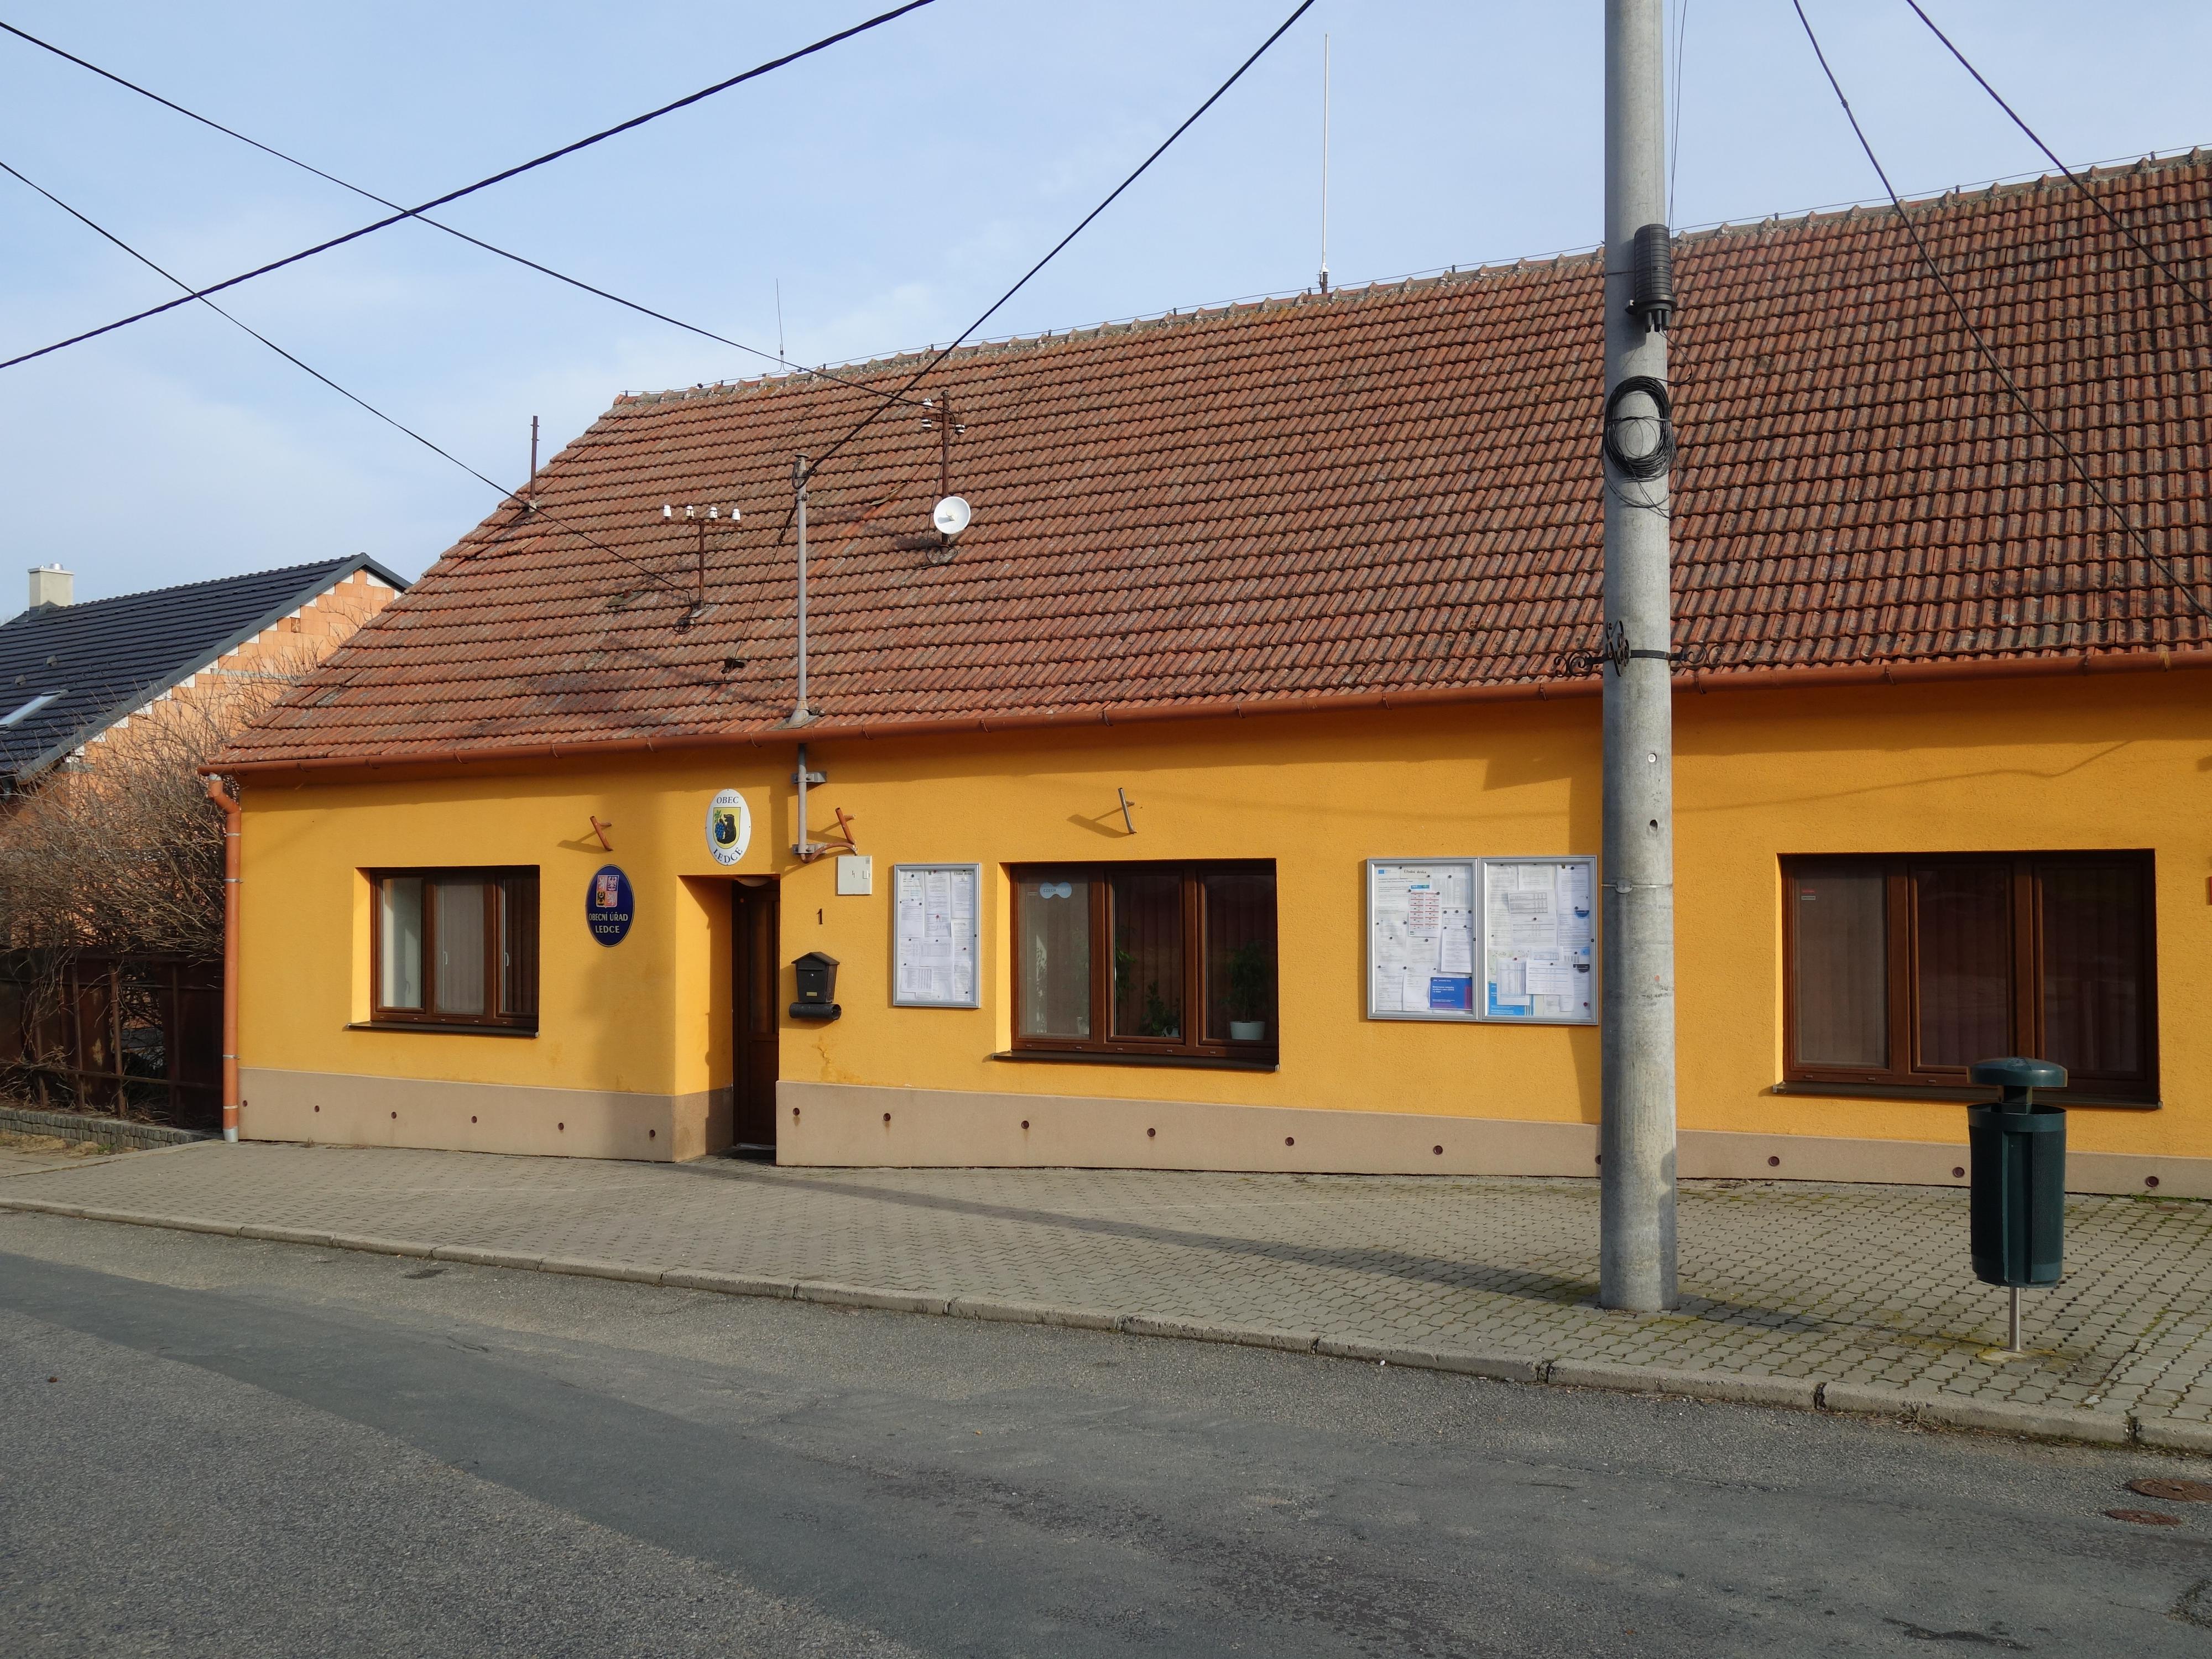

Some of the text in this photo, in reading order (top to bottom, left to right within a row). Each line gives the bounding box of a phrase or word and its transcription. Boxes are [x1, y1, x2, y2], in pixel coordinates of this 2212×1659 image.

[713, 847, 743, 863] LEDCE
[588, 911, 628, 921] OBECNÍ ÚŘAD
[816, 908, 823, 925] 1
[595, 925, 620, 933] LEDCE
